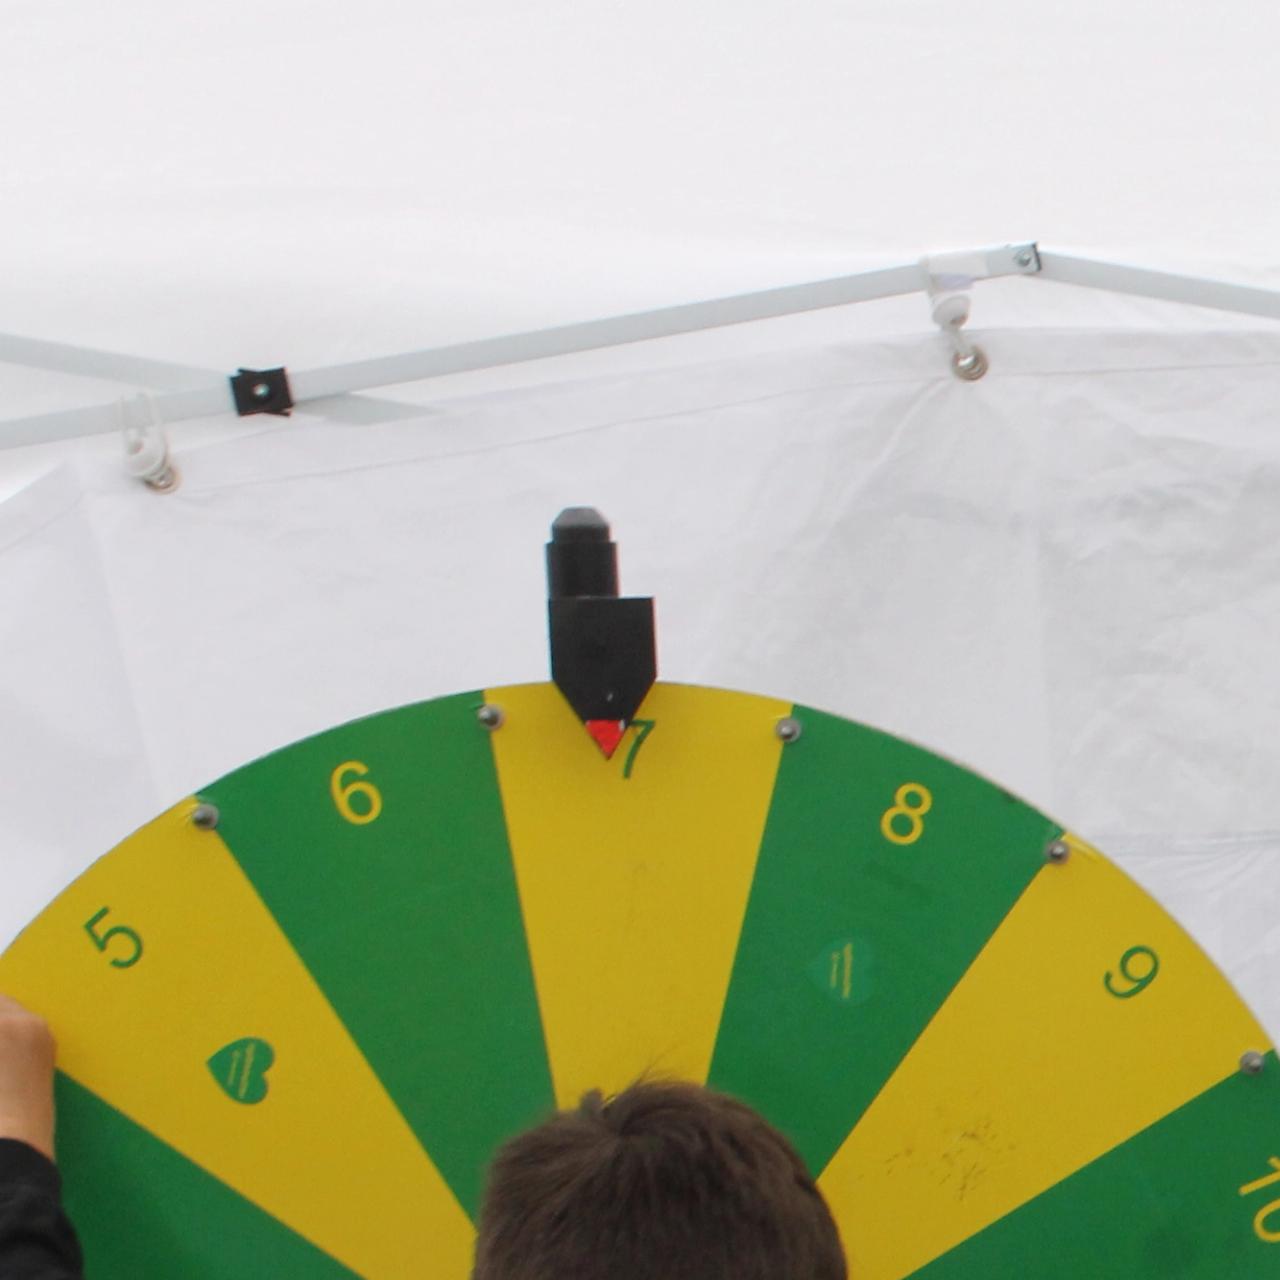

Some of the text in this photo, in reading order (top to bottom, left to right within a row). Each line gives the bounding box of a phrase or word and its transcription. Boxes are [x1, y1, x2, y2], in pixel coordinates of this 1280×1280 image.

[622, 718, 657, 780] 7
[329, 760, 383, 825] 6
[879, 782, 933, 845] 8
[83, 905, 144, 970] 5
[1103, 944, 1161, 1000] 9
